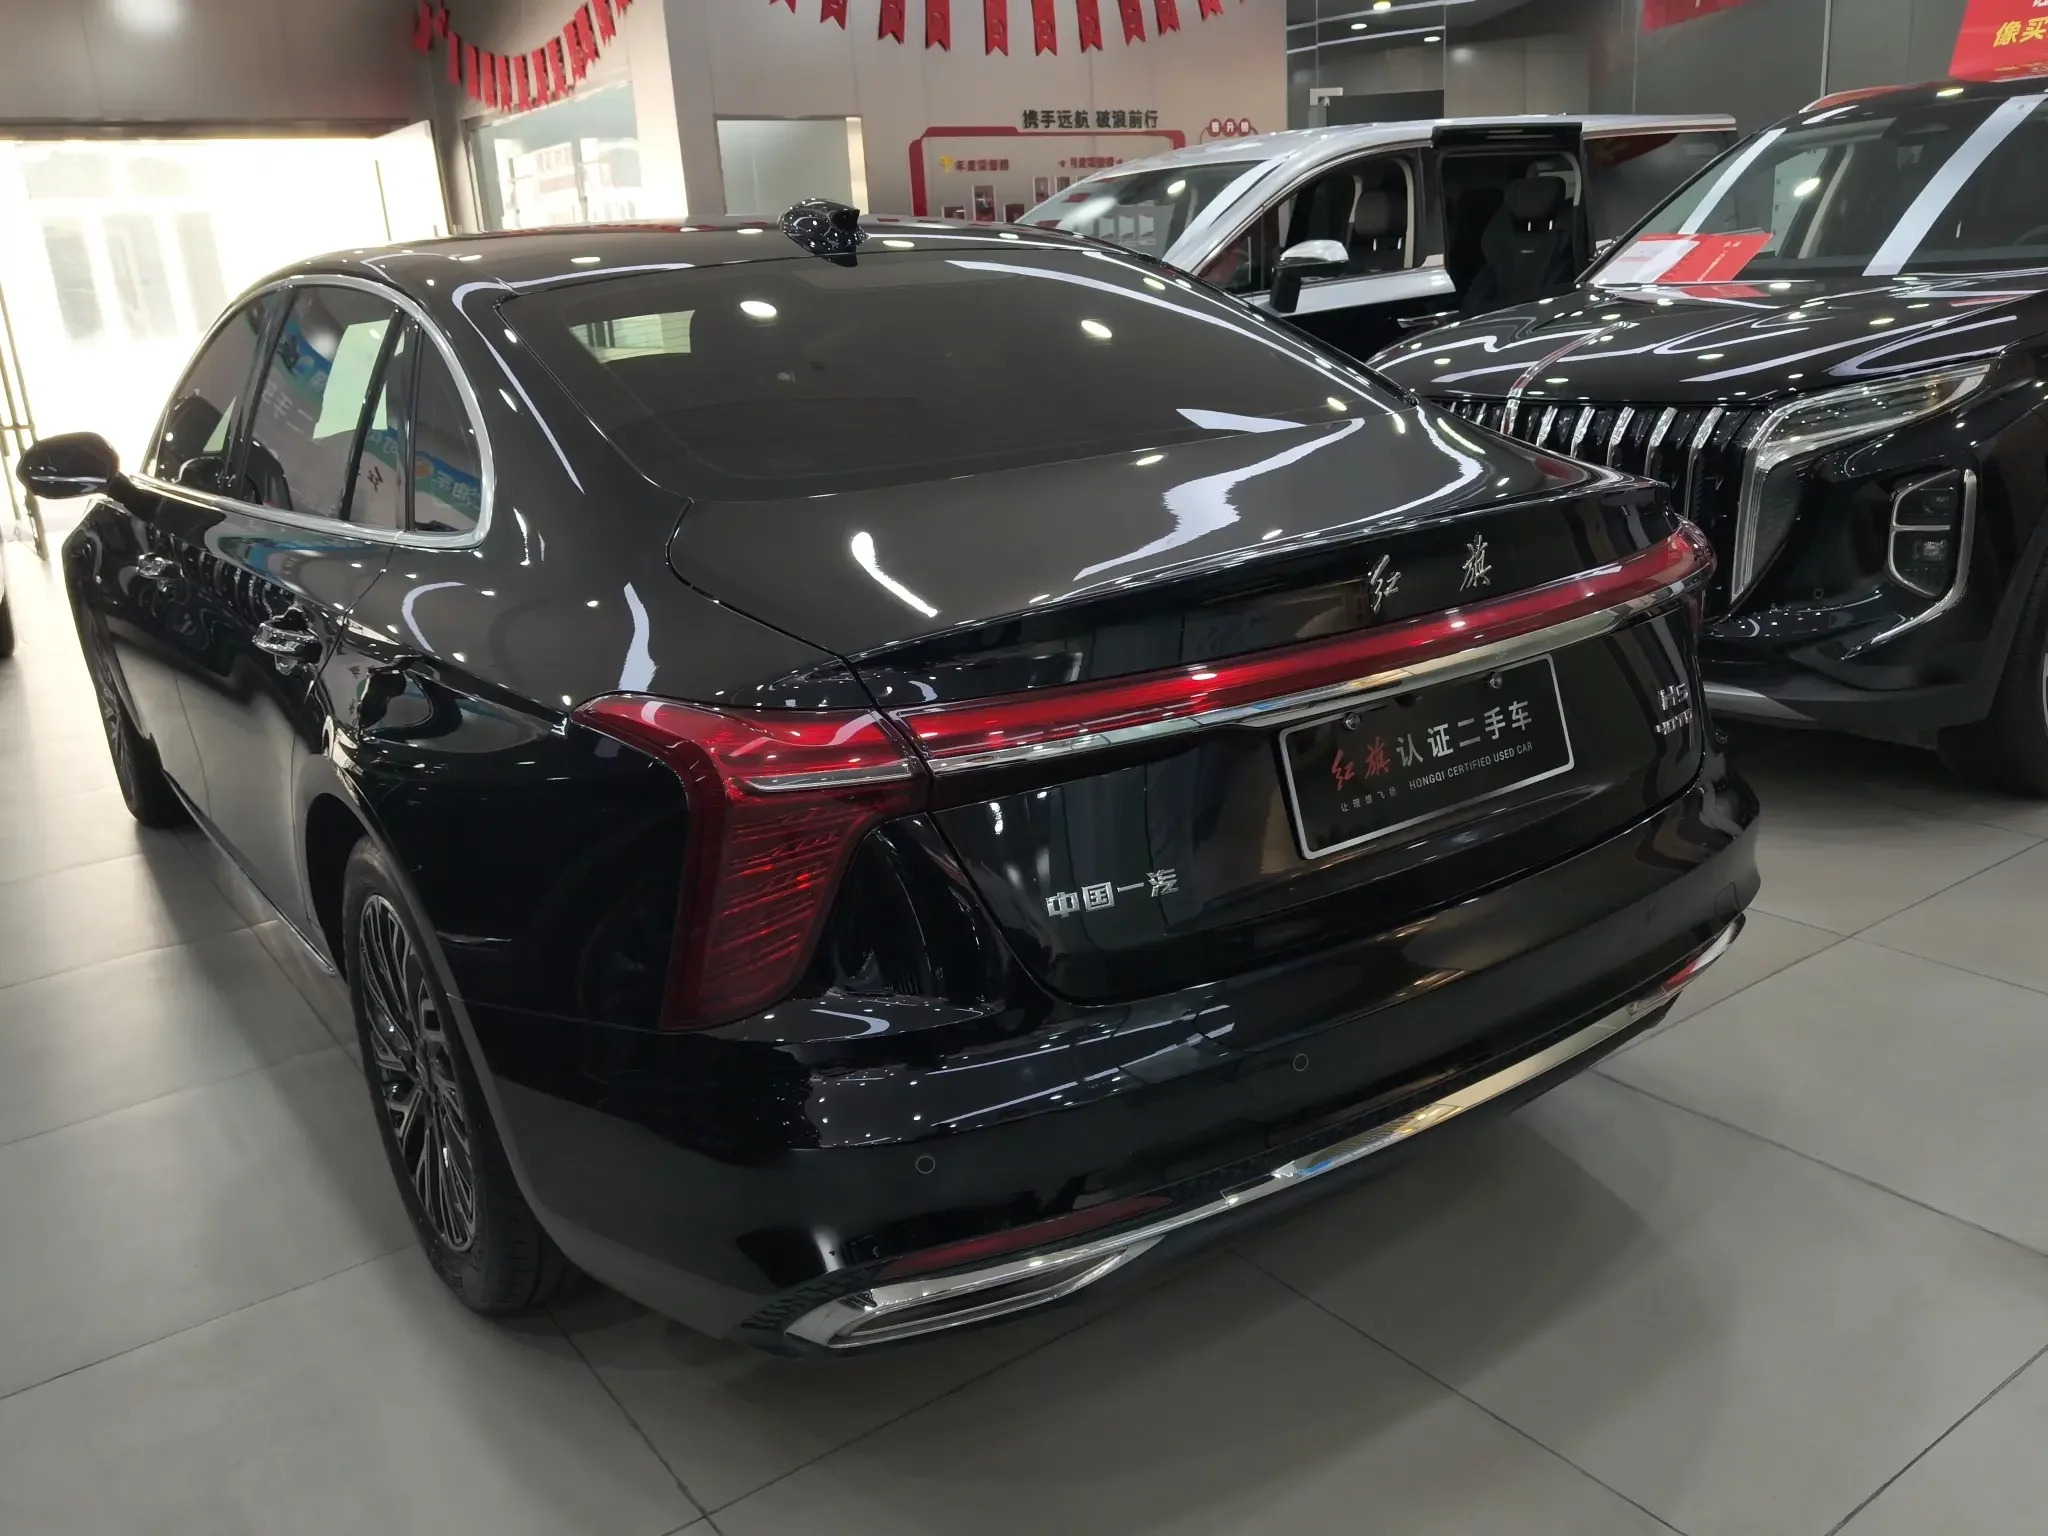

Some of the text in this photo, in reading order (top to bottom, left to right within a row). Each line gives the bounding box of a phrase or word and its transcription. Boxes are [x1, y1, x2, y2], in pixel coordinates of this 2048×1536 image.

[1023, 109, 1158, 129] 携手远航 破浪前行
[1660, 683, 1689, 711] H5
[1331, 700, 1532, 791] 红旗认证二手车
[1409, 741, 1533, 790] HONGQI CERTIFIED USED CAR
[1340, 786, 1397, 812] 让理想飞扬
[1046, 869, 1180, 919] 中国一汽
